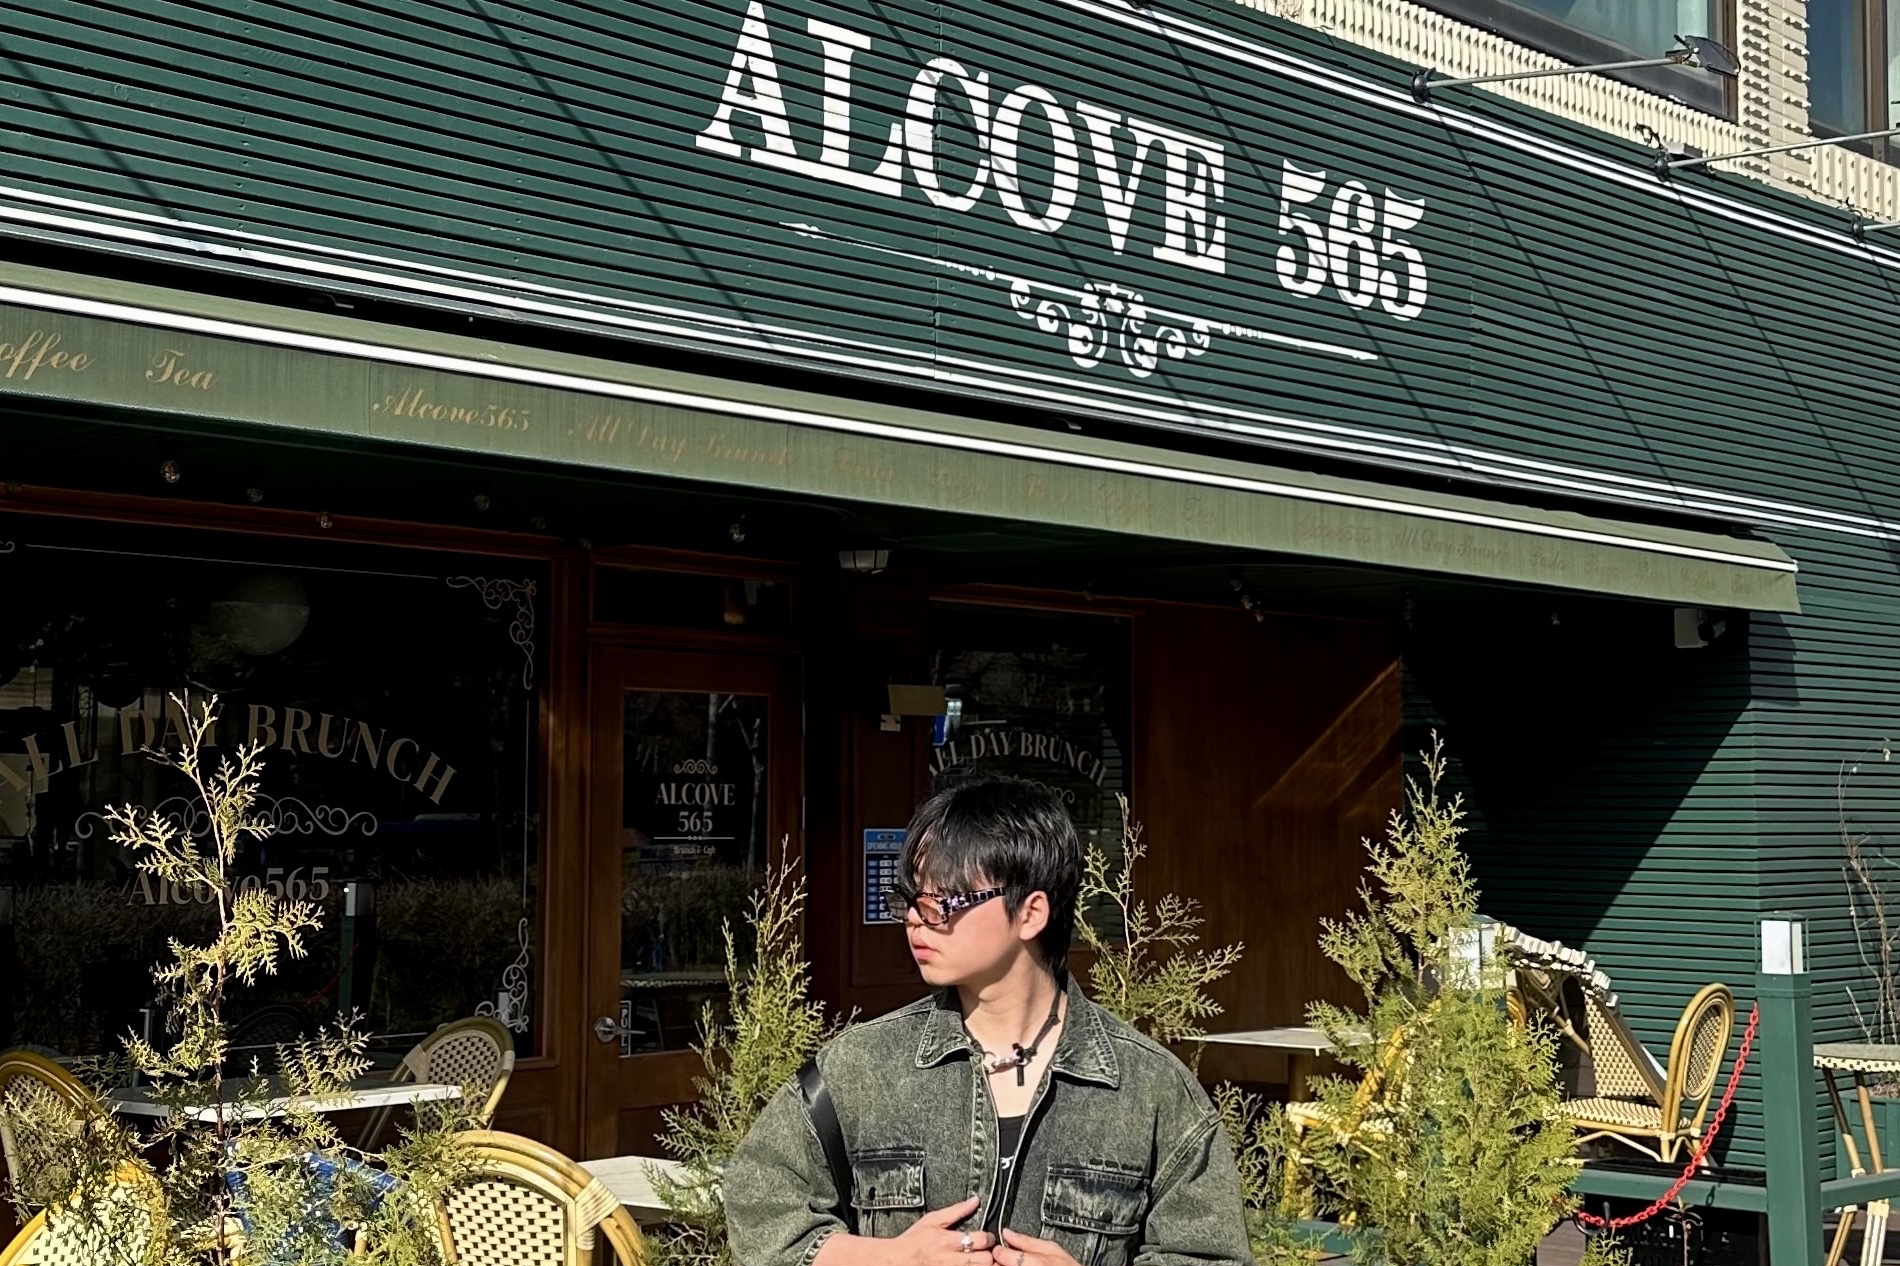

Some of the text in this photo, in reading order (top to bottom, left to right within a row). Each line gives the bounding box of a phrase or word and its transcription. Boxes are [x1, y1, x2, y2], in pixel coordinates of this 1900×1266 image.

[696, 0, 1428, 322] ALCOVE 565
[0, 329, 217, 390] offee Tea
[246, 703, 458, 806] BRUNCH
[970, 730, 1013, 760] DAY
[1019, 731, 1107, 788] BRUNCH
[655, 782, 736, 806] ALCOVE
[678, 810, 713, 832] 565
